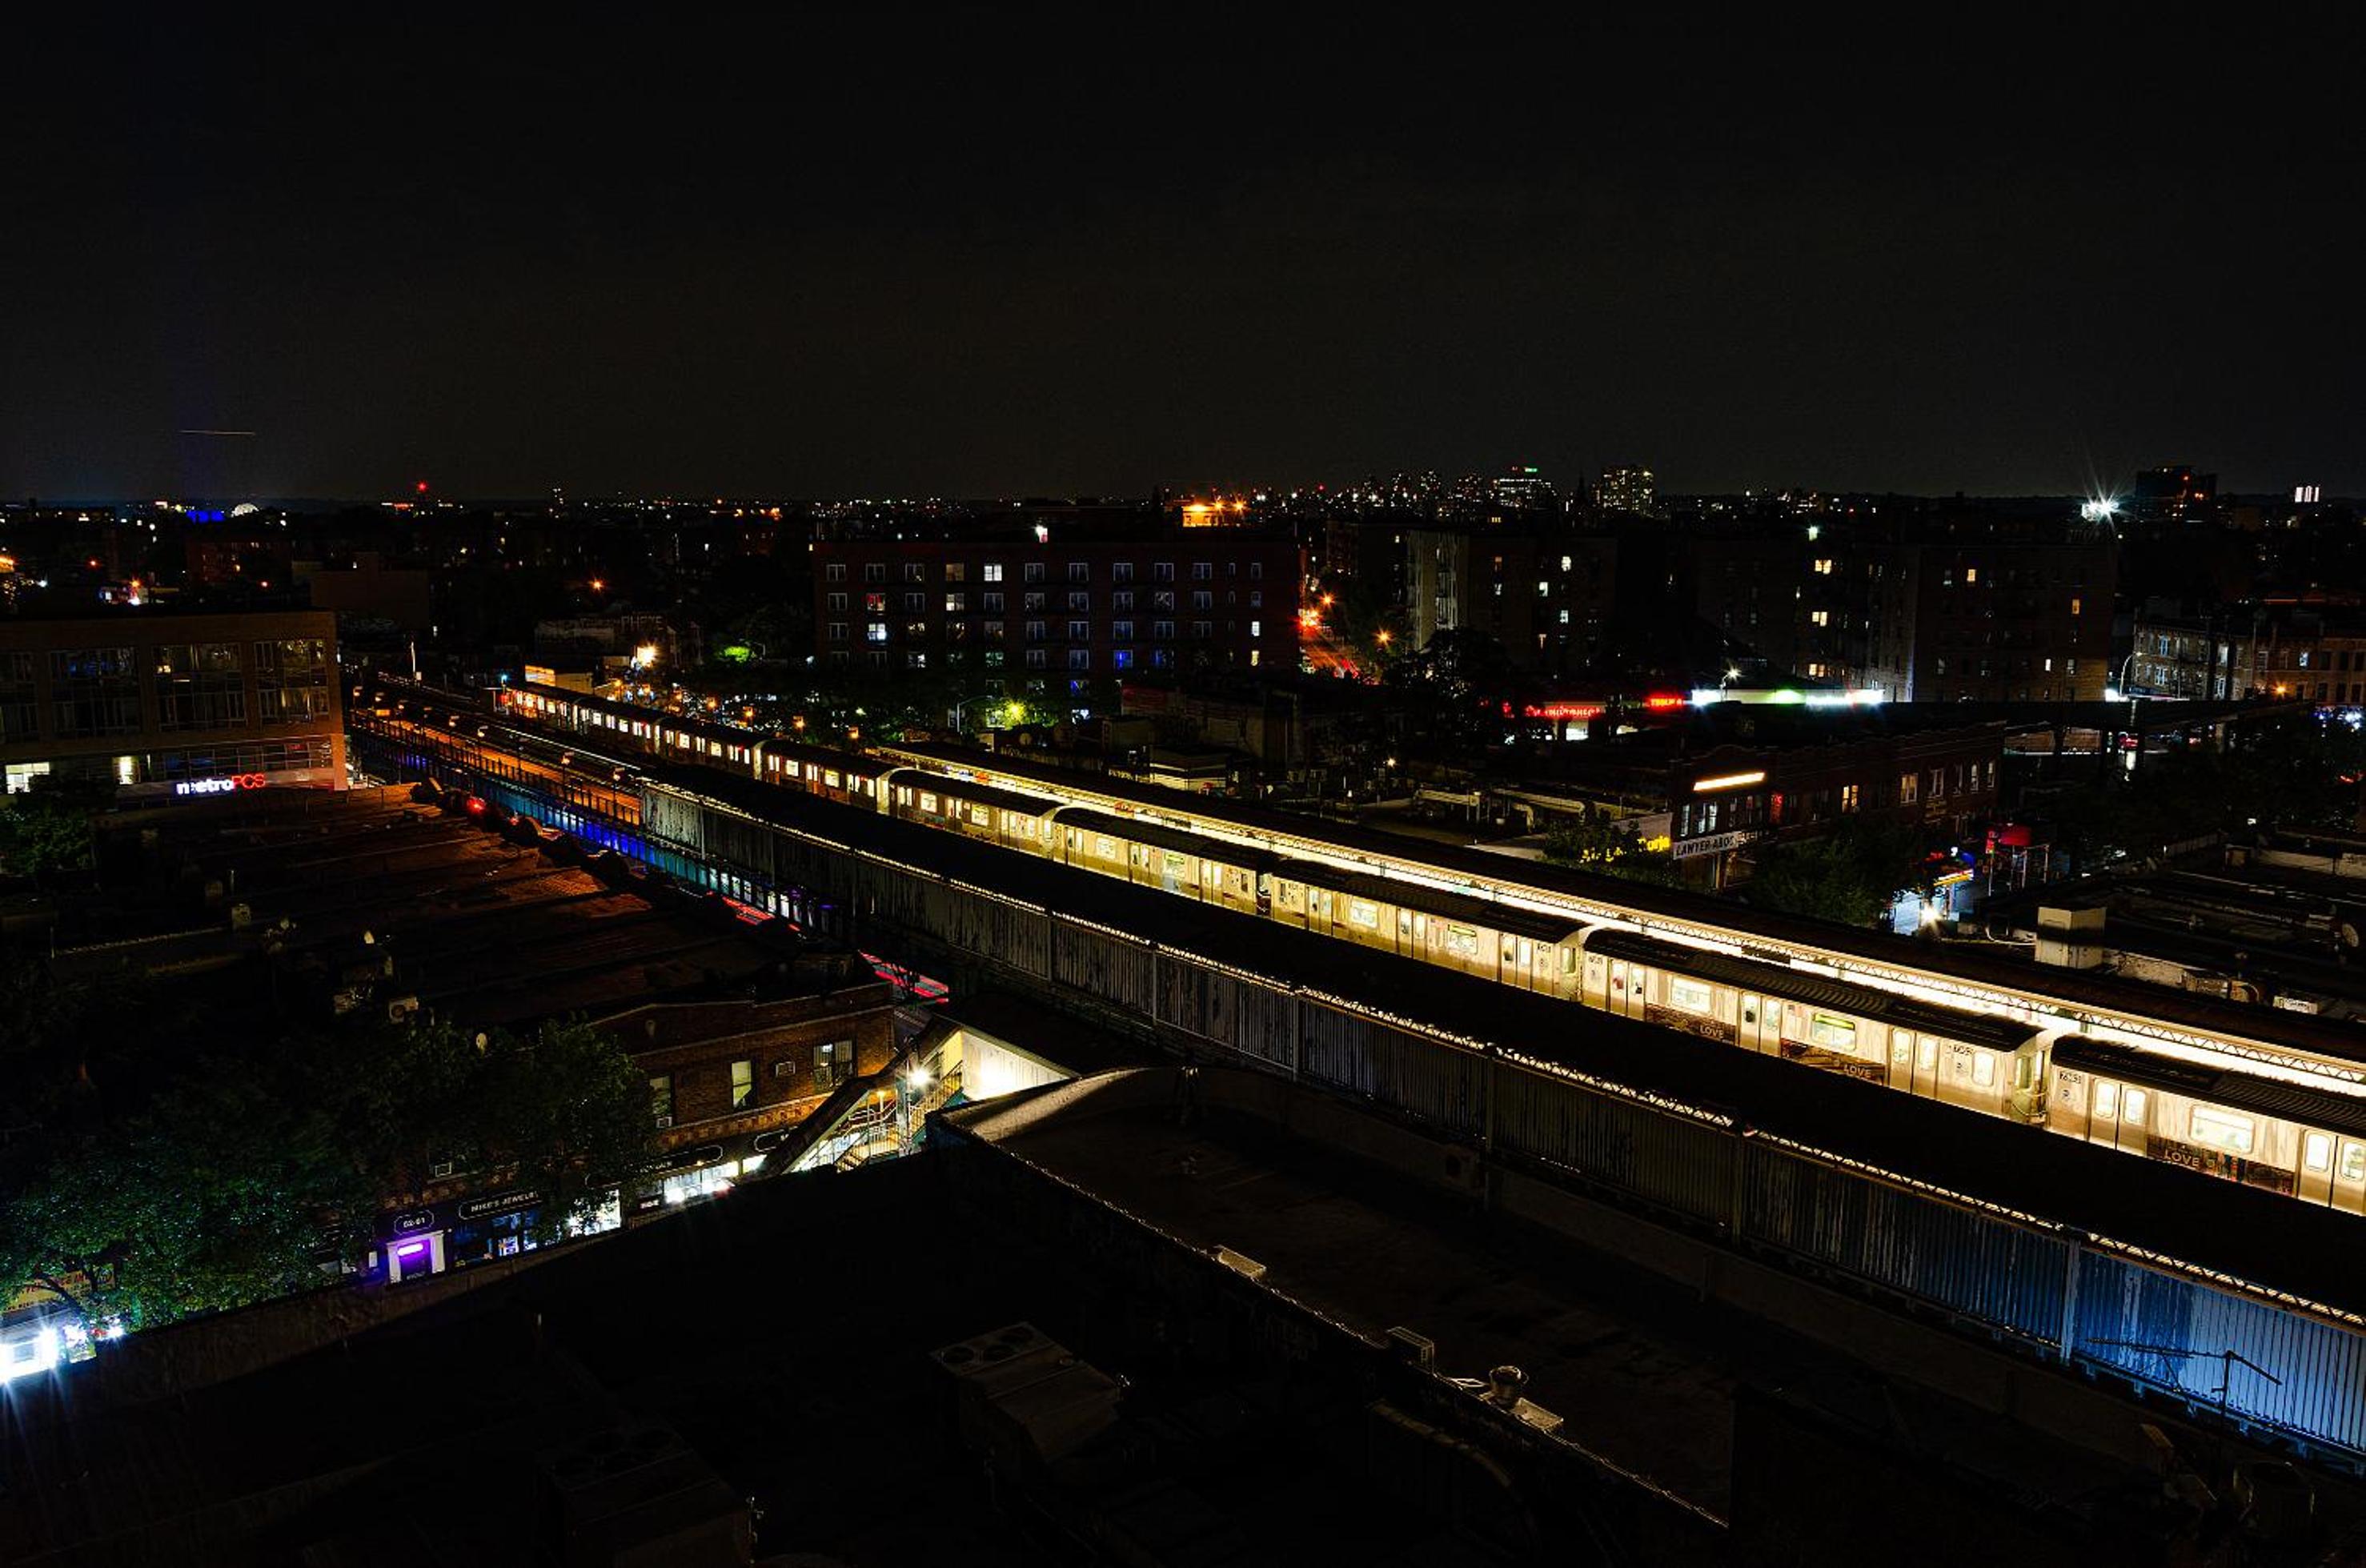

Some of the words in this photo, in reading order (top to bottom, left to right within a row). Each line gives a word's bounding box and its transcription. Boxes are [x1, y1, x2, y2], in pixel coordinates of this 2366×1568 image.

[176, 773, 266, 794] metroPCS
[1699, 1025, 1724, 1039] LOVE
[1843, 1064, 1871, 1078] LOVE
[2163, 1149, 2200, 1167] LOVE
